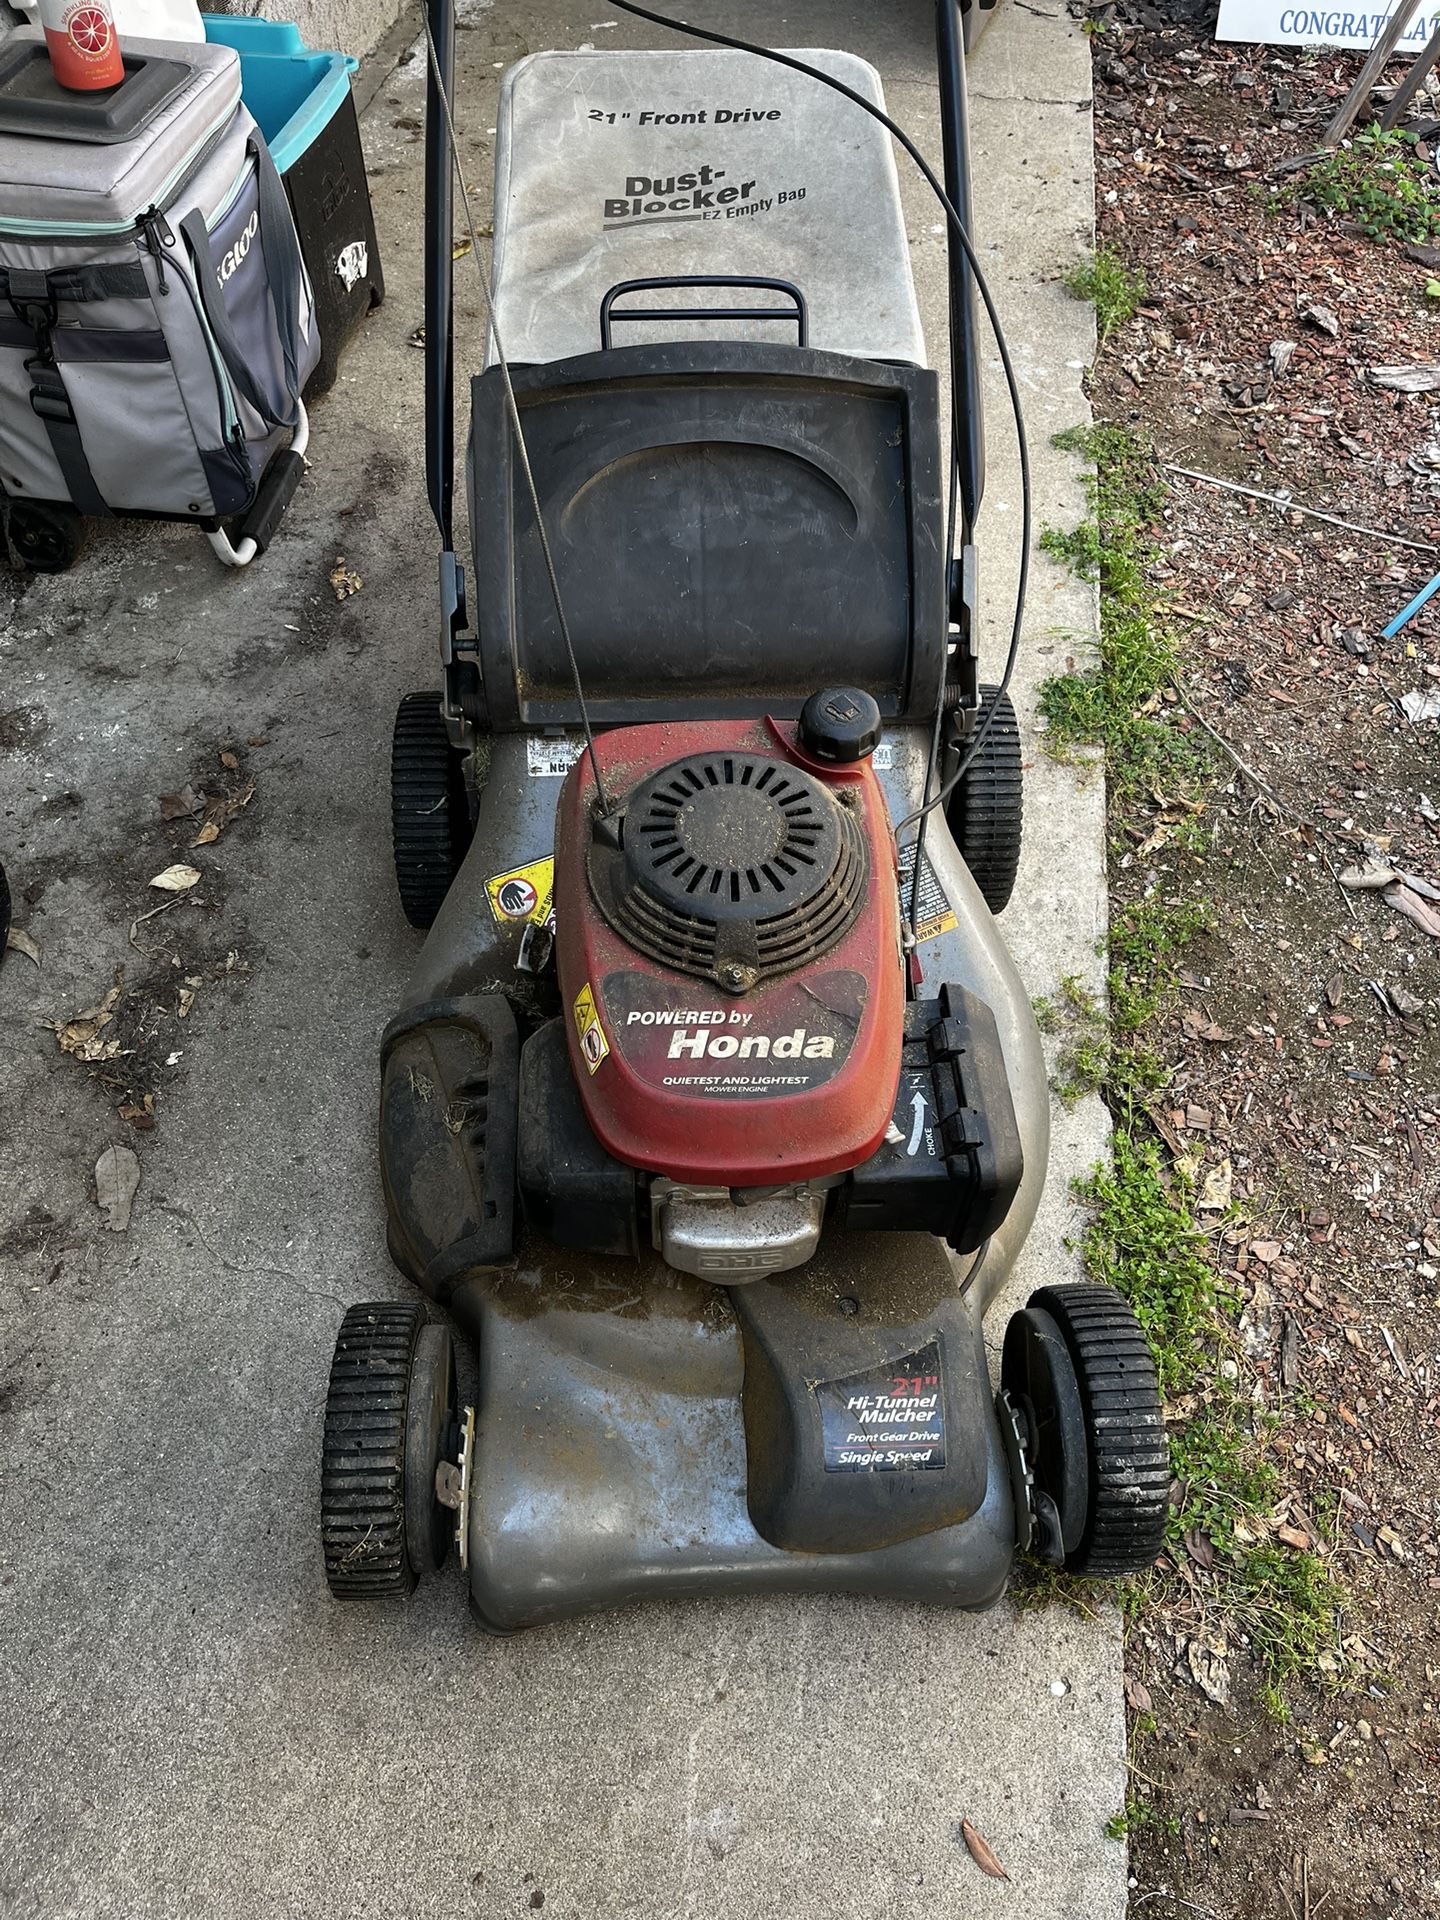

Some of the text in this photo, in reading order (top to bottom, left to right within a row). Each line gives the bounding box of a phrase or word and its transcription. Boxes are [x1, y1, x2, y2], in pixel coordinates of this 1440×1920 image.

[638, 108, 707, 126] Front
[714, 108, 782, 124] Drive
[625, 165, 726, 197] Dust-
[603, 179, 756, 218] Blocker
[702, 187, 807, 221] EZ Empty Bag
[626, 1010, 753, 1027] POWERED by
[667, 1029, 836, 1059] Honda
[663, 1076, 810, 1086] QUIETEST AND LIGHTEST
[924, 1127, 936, 1156] CHOKE
[890, 1376, 939, 1396] 21"
[847, 1394, 937, 1410] Hi-Tunnel
[859, 1409, 936, 1423] Mulcher
[846, 1431, 940, 1443] Front Gear Drive
[838, 1449, 932, 1465] Single Speed
